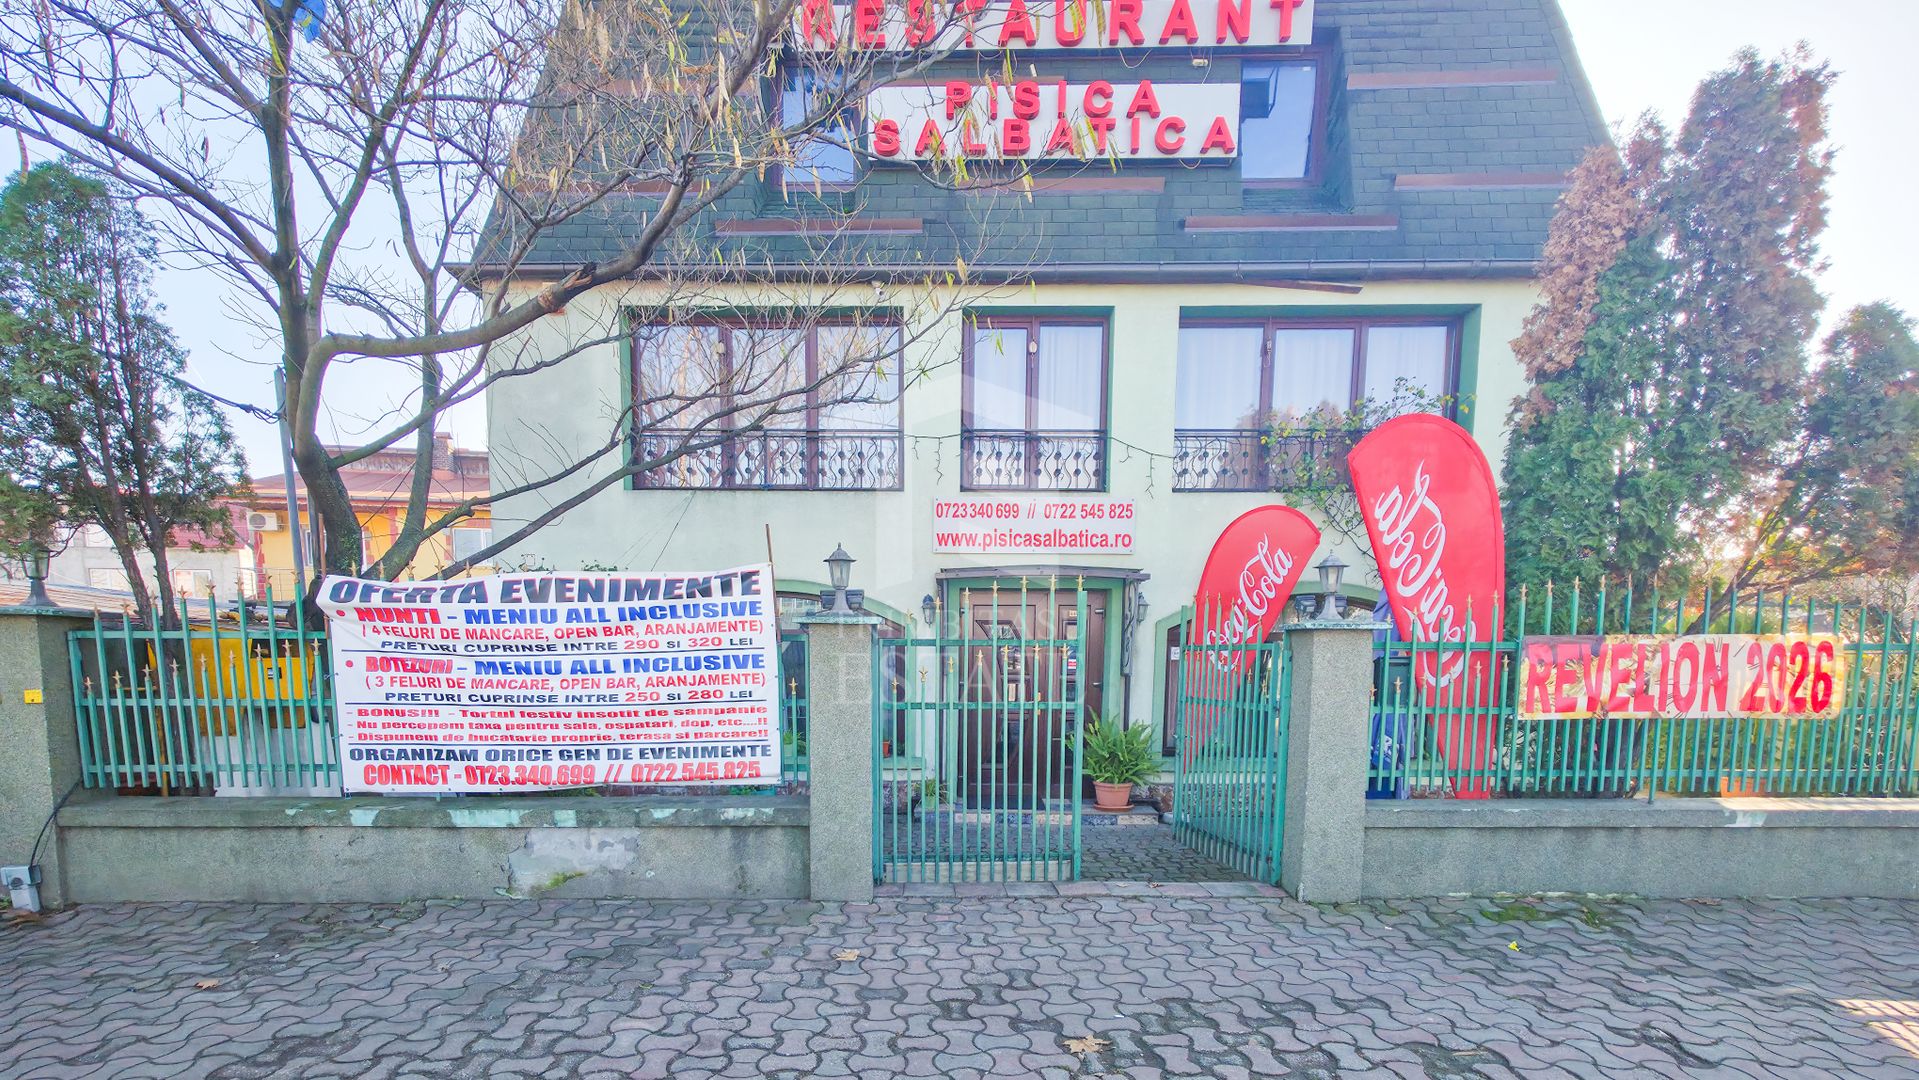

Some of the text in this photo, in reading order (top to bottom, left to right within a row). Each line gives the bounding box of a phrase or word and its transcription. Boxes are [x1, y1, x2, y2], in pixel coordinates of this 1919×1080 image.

[801, 0, 1302, 48] RESTAURANT
[946, 80, 1161, 120] PISICA
[873, 116, 1236, 156] SALBATICA
[1044, 502, 1076, 519] 0722
[1080, 502, 1104, 520] 545
[1109, 502, 1133, 519] 825
[936, 528, 1133, 551] www.pisicasalbatica.ro
[329, 570, 761, 603] OFERTA EVENIMENTE
[354, 607, 441, 624] NUNTI
[464, 608, 557, 624] MENIU
[565, 607, 611, 623] ALL
[617, 601, 763, 622] INCLUSIVE
[381, 627, 435, 639] FELURI
[441, 628, 460, 639] DE
[466, 628, 549, 642] MANCARE,
[554, 627, 598, 639] OPEN
[603, 624, 639, 638] BAR,
[645, 620, 763, 636] ARANJAMENTE)
[381, 641, 457, 652] PRETURI
[464, 643, 558, 652] CUPRINSE
[564, 642, 618, 651] INTRE
[624, 639, 659, 650] 290
[688, 637, 722, 647] 320
[730, 638, 753, 646] LEI
[366, 656, 453, 674] BOTEZURI
[475, 660, 562, 675] MENIU
[570, 659, 616, 675] ALL
[623, 654, 765, 673] INCLUSIVE
[389, 676, 441, 689] FELURI
[446, 676, 465, 689] DE
[471, 678, 554, 692] MANCARE,
[560, 677, 601, 690] OPEN
[607, 676, 640, 690] BAR,
[645, 673, 766, 688] ARANJAMENTE)
[1525, 640, 1834, 713] REVELION 2026
[385, 692, 461, 702] PRETURI
[469, 694, 558, 703] CUPRINSE
[565, 694, 619, 703] INTRE
[625, 692, 660, 702] 250
[688, 690, 724, 699] 280
[357, 709, 440, 717] BONUS!!!
[459, 709, 515, 718] Tortul
[519, 709, 572, 719] festiv
[577, 709, 641, 718] insotit
[644, 708, 669, 717] de
[674, 705, 768, 717] sampanie
[357, 721, 377, 729] Nu
[381, 722, 465, 730] percepem
[468, 721, 502, 730] taxa
[505, 721, 560, 731] pentru
[563, 722, 601, 731] sala,
[358, 733, 438, 742] Dispunem
[443, 733, 464, 741] de
[468, 733, 547, 742] bucatarie
[620, 732, 671, 740] terasa
[675, 731, 690, 739] si
[694, 729, 769, 740] parcare!!
[350, 744, 772, 762] ORGANIZAM ORICE GEN DE EVENIMENTE
[363, 764, 450, 785] CONTACT
[465, 764, 596, 786] 0723.340.699
[631, 760, 761, 783] 0722.545.825
